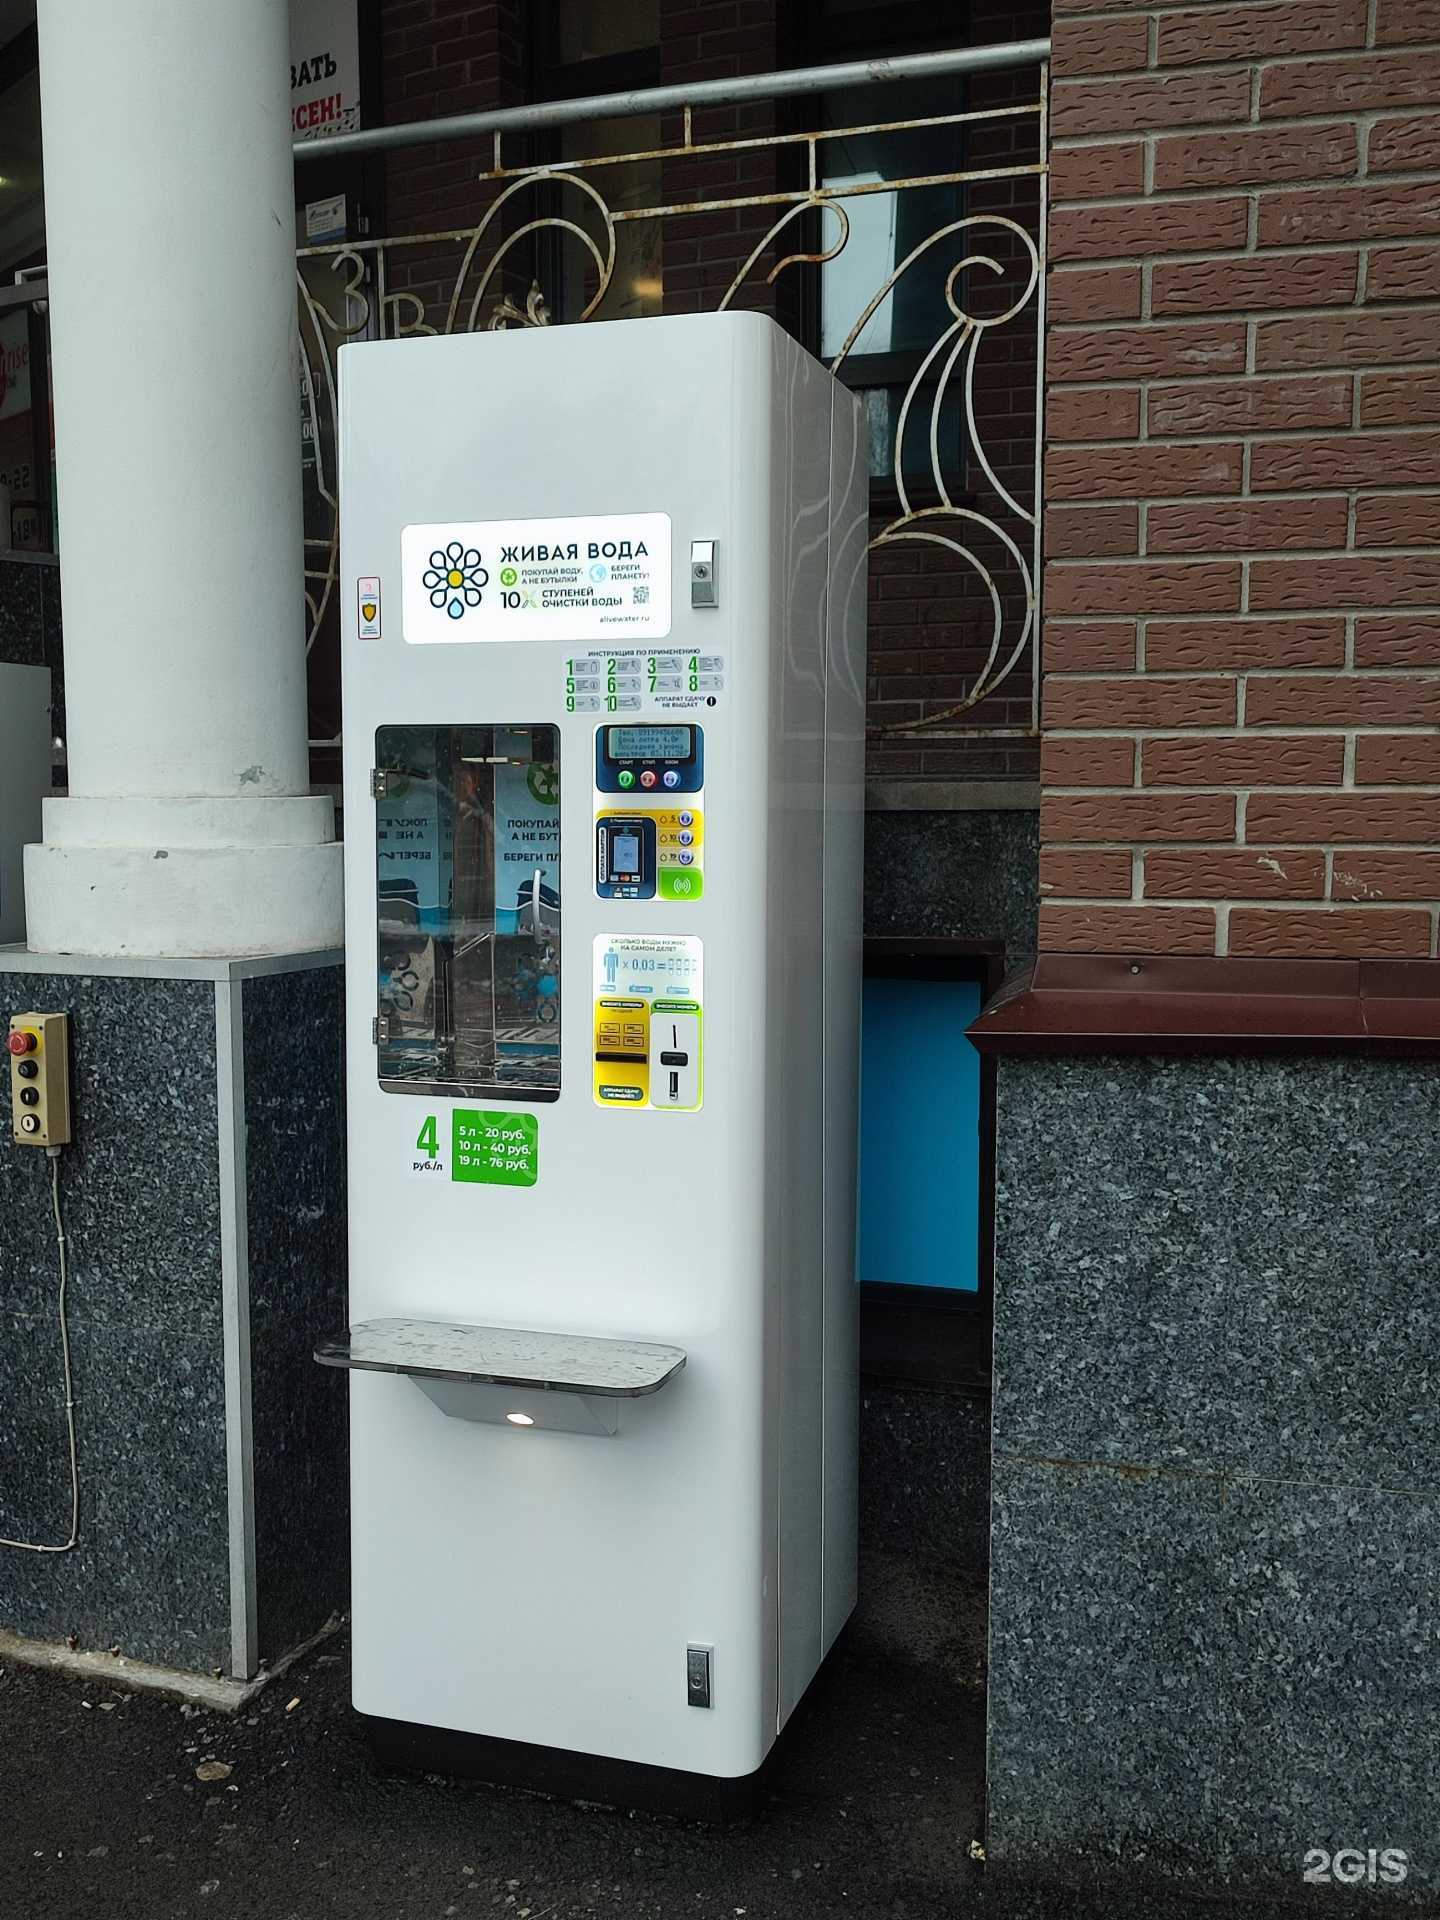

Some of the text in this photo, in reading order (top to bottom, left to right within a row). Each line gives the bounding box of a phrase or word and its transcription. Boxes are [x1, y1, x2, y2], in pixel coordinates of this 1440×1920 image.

[292, 93, 342, 132] СЕН!
[500, 541, 648, 563] ЖИВАЯ ВОДА
[521, 567, 583, 576] ПОКУПАЙ ВОДУ,
[611, 564, 640, 572] БЕРЕГИ
[540, 576, 578, 584] БУТЫЛКИ
[542, 587, 594, 598] СТУПЕНЕЙ
[500, 591, 521, 609] 10
[542, 598, 623, 608] ОЧИСТКИ ВОДЫ
[648, 648, 701, 656] ПРИМЕНЕНИЮ
[566, 659, 573, 675] 1
[607, 659, 616, 675] 2
[648, 657, 656, 674] 3
[688, 656, 697, 673] 4
[566, 678, 575, 694] 5
[607, 677, 616, 693] 6
[649, 676, 657, 692] 7
[689, 675, 698, 692] 8
[566, 696, 575, 712] 9
[604, 695, 617, 712] 10
[511, 832, 518, 841] А
[522, 832, 536, 841] НЕ
[504, 853, 543, 862] БЕРЕГИ
[632, 959, 655, 971] 0,03
[416, 1115, 440, 1159] 4
[459, 1126, 466, 1136] 5
[468, 1128, 476, 1136] л
[485, 1127, 499, 1138] 20
[502, 1129, 525, 1142] руб.
[459, 1140, 471, 1151] 10
[473, 1143, 481, 1151] л
[490, 1142, 505, 1153] 40
[507, 1144, 531, 1156] руб.
[413, 1161, 443, 1172] руб./л
[459, 1155, 470, 1165] 19
[471, 1158, 480, 1166] л
[489, 1157, 503, 1168] 76
[505, 1158, 529, 1171] руб.
